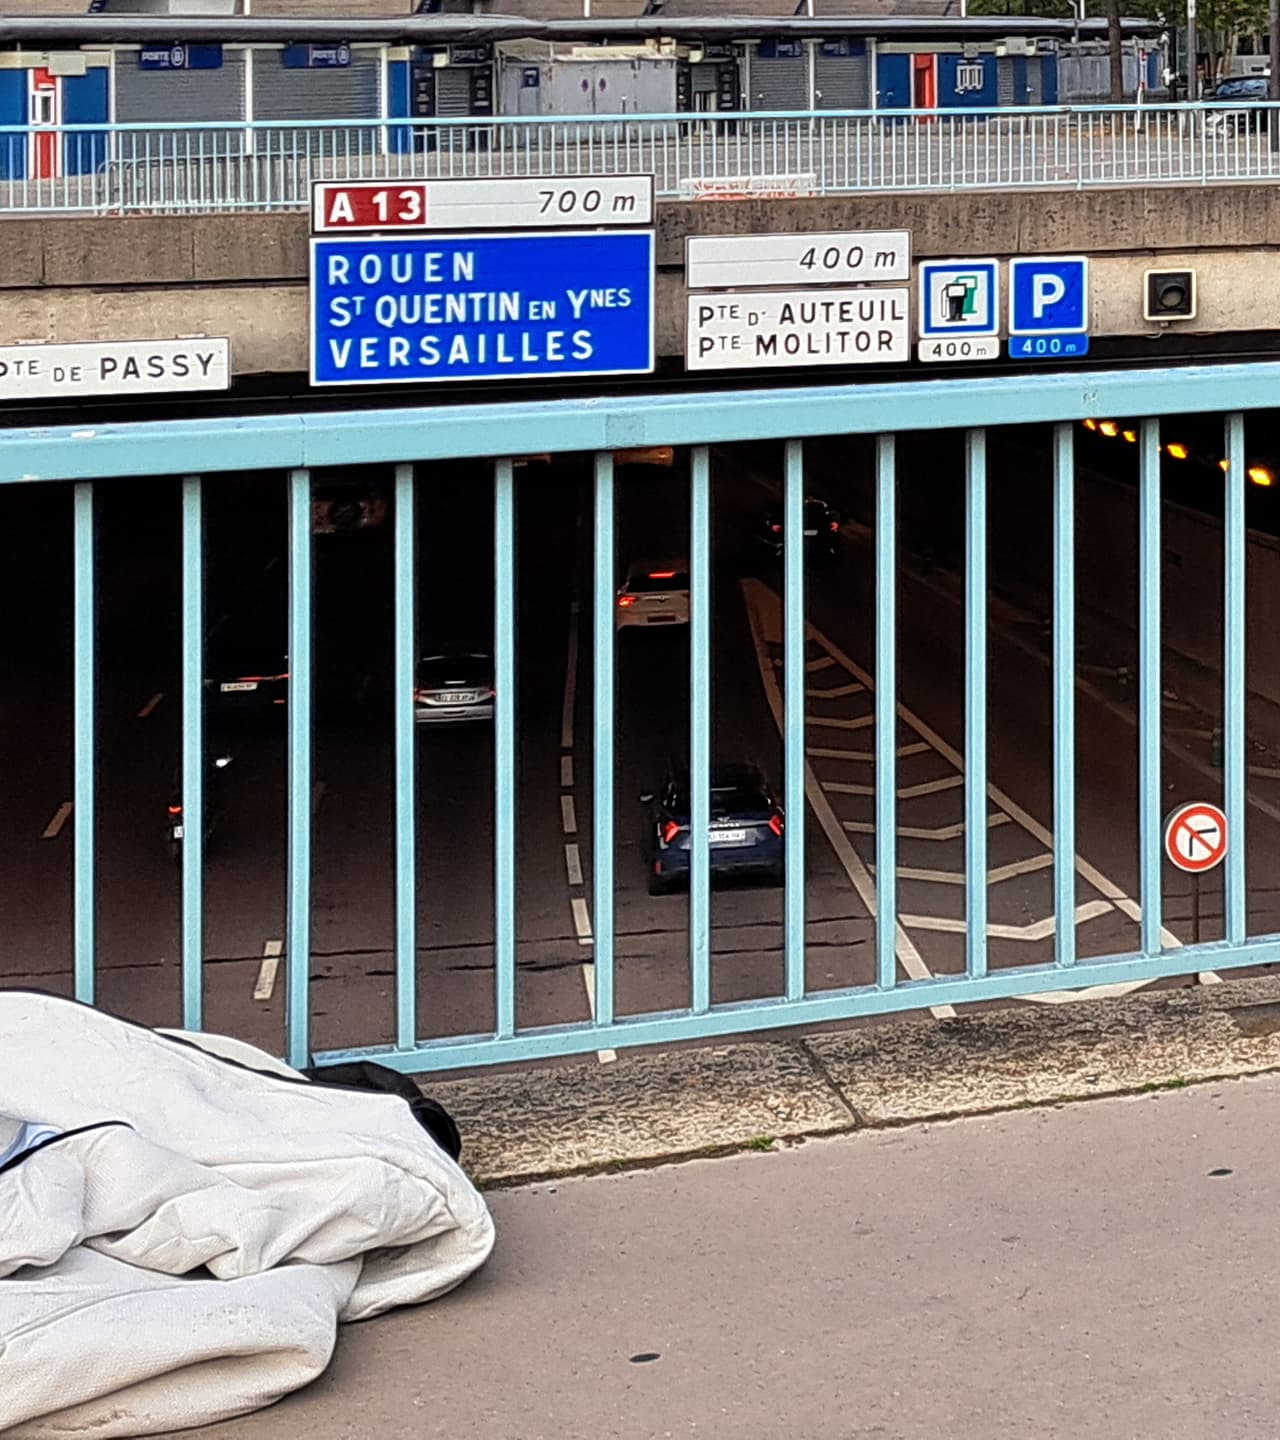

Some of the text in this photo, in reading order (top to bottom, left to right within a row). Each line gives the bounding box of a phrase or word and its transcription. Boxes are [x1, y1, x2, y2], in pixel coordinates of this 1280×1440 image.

[329, 190, 422, 223] A 13
[538, 190, 636, 214] 700 m
[328, 251, 475, 285] ROUEN
[800, 246, 896, 270] 400 m
[375, 291, 520, 328] QUENTIN
[528, 300, 556, 321] EN
[1032, 273, 1066, 319] P
[779, 299, 904, 325] AUTEUIL
[328, 330, 594, 369] VERSAILLES
[756, 330, 894, 356] MOLITOR
[932, 342, 987, 358] 400 m
[1021, 338, 1077, 355] 400 m
[53, 367, 82, 383] DE
[100, 353, 215, 381] PASSY
